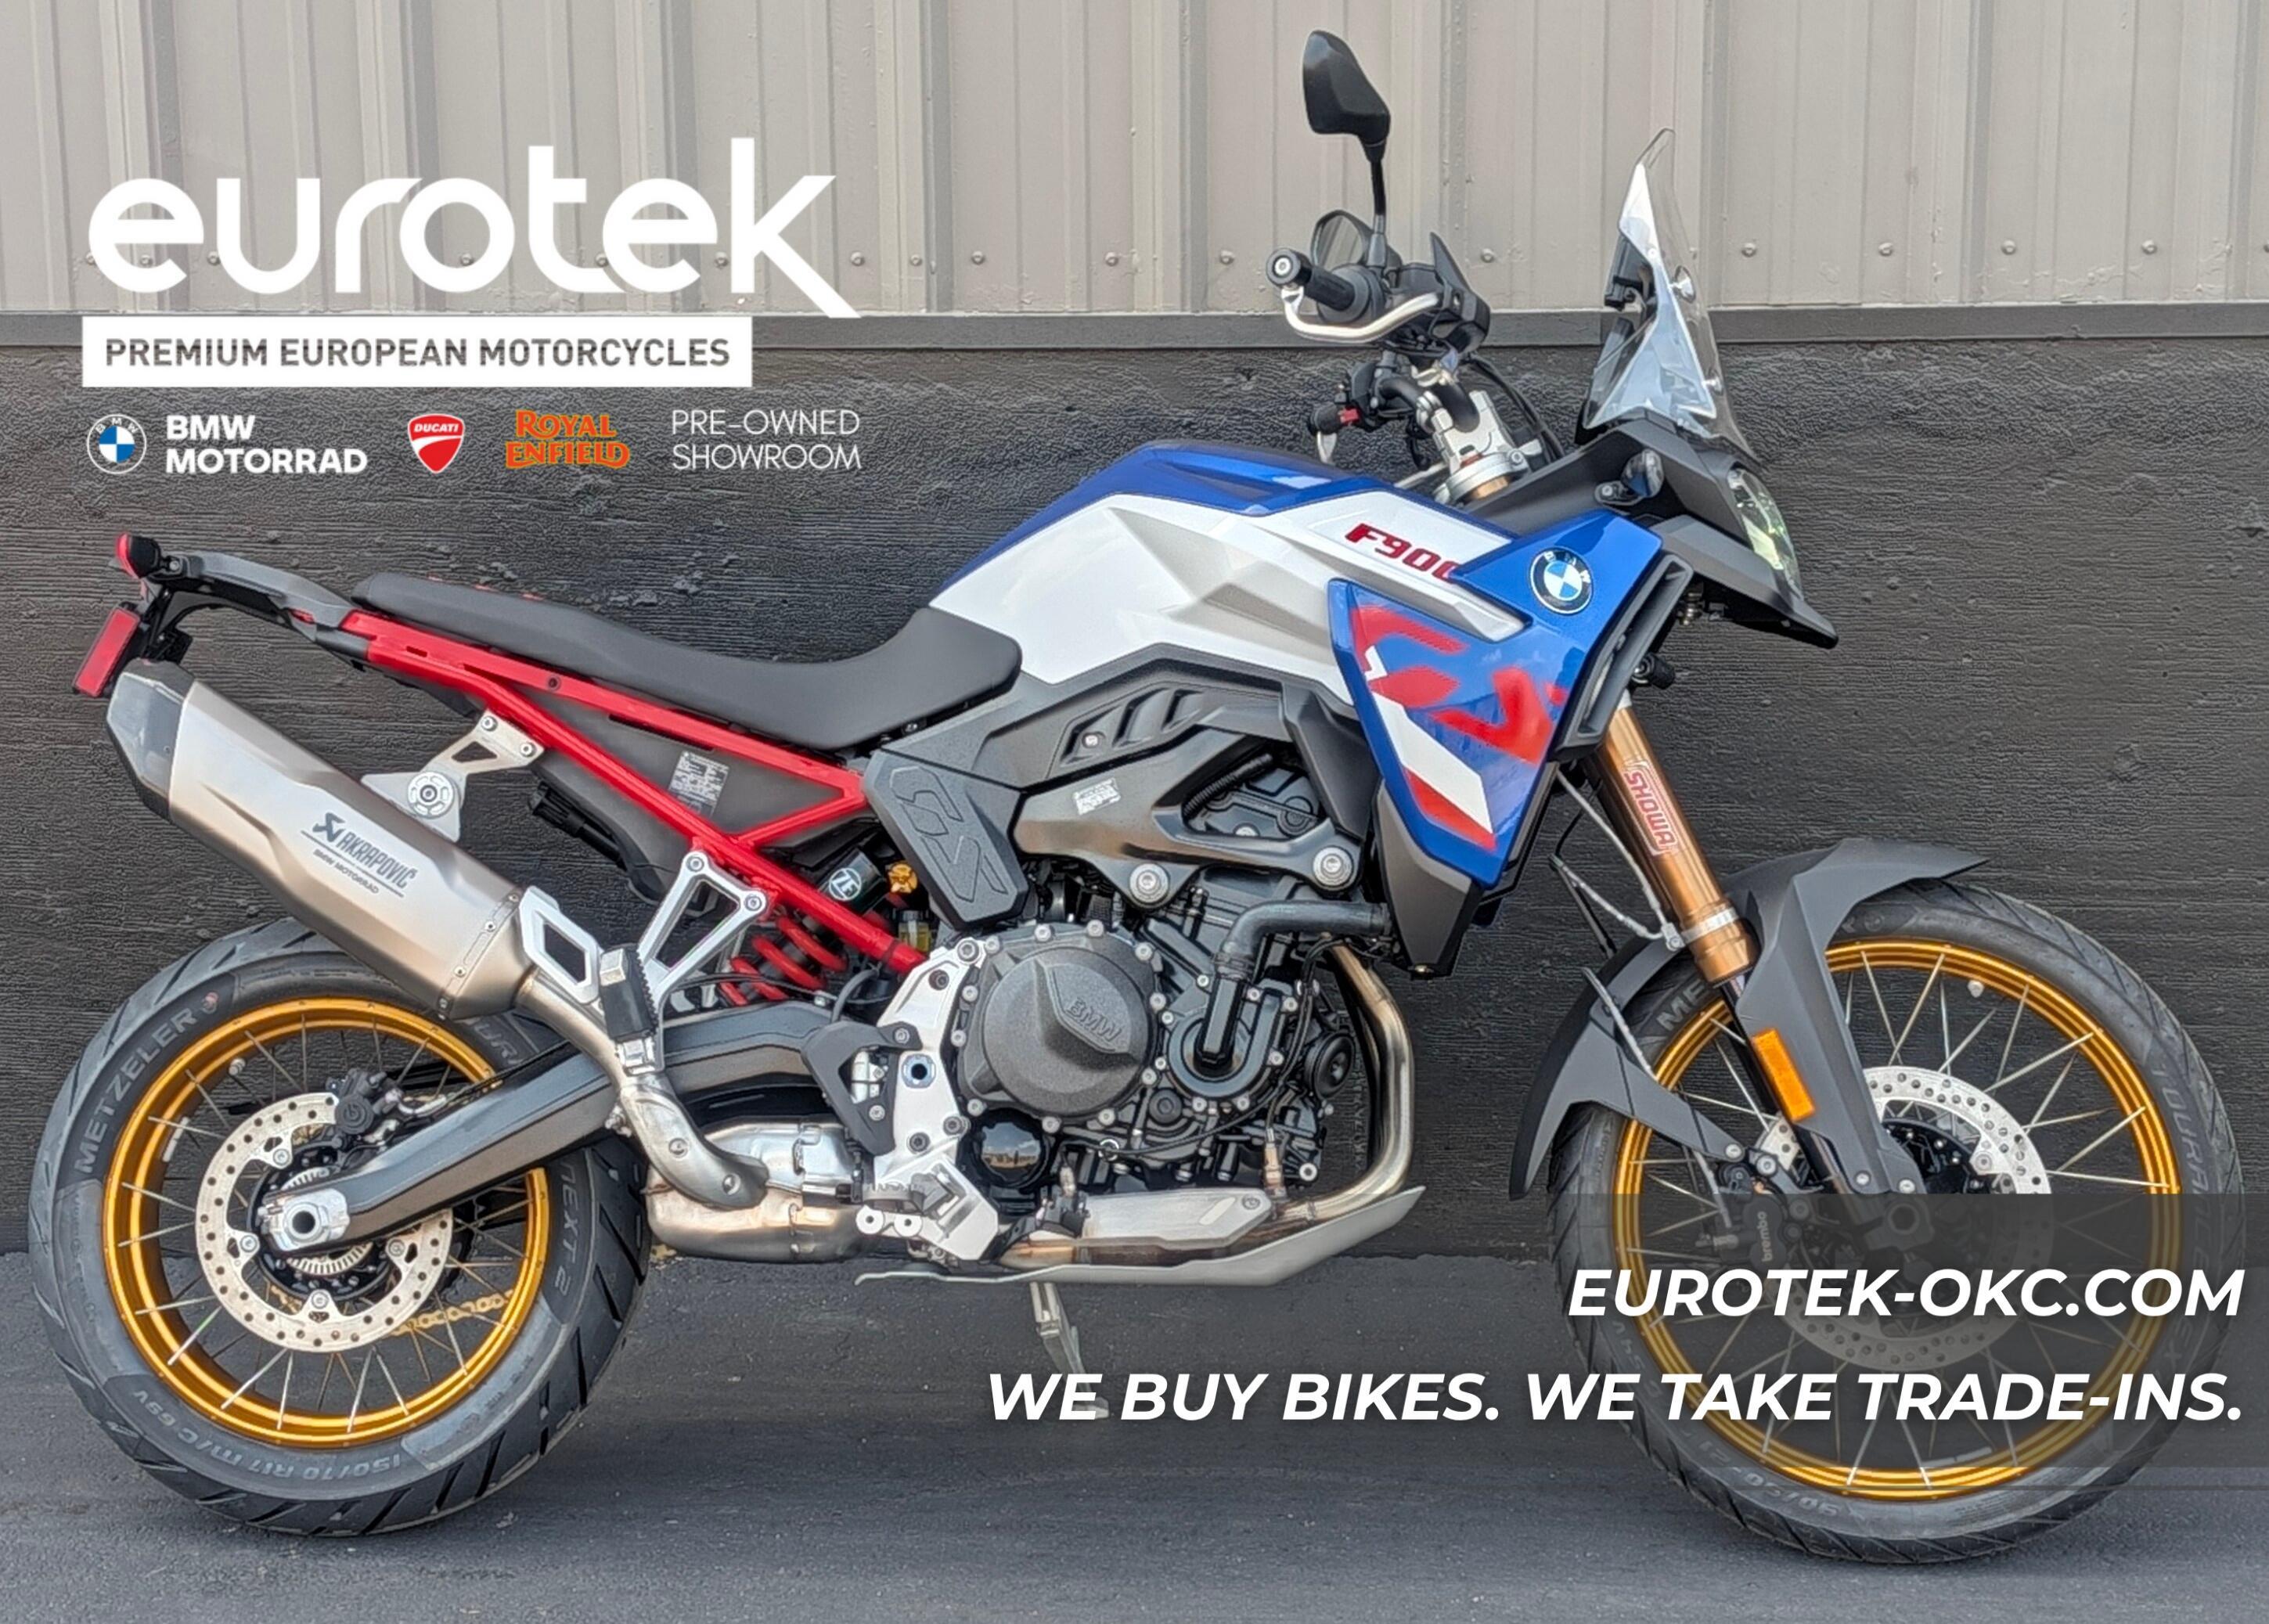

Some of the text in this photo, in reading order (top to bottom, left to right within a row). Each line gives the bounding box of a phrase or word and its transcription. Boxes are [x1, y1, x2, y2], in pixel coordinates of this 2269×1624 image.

[1623, 771, 1677, 845] SHOWA
[334, 862, 380, 894] MOTORRAD
[832, 872, 859, 898] ZF
[1066, 996, 1122, 1042] BMW
[74, 1007, 198, 1174] METZELER
[1756, 1211, 1774, 1263] brembo
